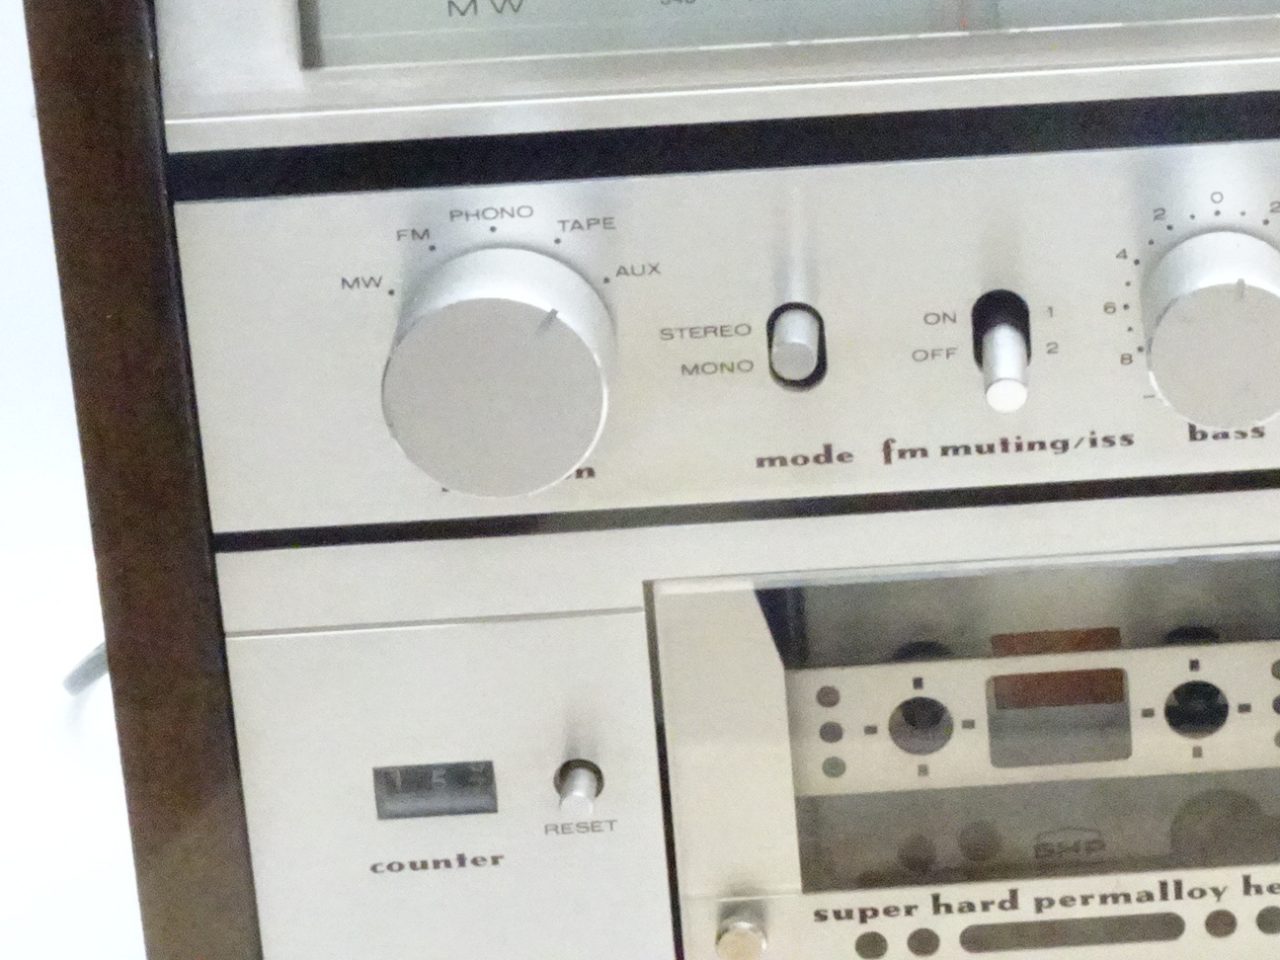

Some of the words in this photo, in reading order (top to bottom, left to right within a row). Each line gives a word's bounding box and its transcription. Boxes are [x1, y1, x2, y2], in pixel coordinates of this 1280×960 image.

[1210, 191, 1224, 204] 0
[449, 205, 534, 223] PHONO
[1153, 207, 1168, 221] 2
[557, 216, 617, 234] TAPE
[396, 228, 431, 243] FM
[1115, 248, 1128, 261] 4
[615, 261, 662, 279] AUX
[341, 274, 383, 291] MW
[1047, 306, 1055, 319] 1
[1103, 302, 1117, 315] 6
[923, 311, 957, 326] ON
[660, 323, 752, 342] STEREO
[912, 348, 957, 363] OFF
[1046, 342, 1059, 355] 2
[681, 359, 754, 377] MONO
[1120, 353, 1134, 366] 8
[1188, 422, 1266, 442] bass
[756, 444, 855, 468] mode
[883, 438, 929, 466] fm
[940, 429, 1135, 458] muting/iss
[544, 819, 618, 836] RESET
[369, 853, 505, 875] counter
[813, 901, 919, 924] super
[931, 889, 1020, 916] hard
[1034, 878, 1229, 912] permalloy
